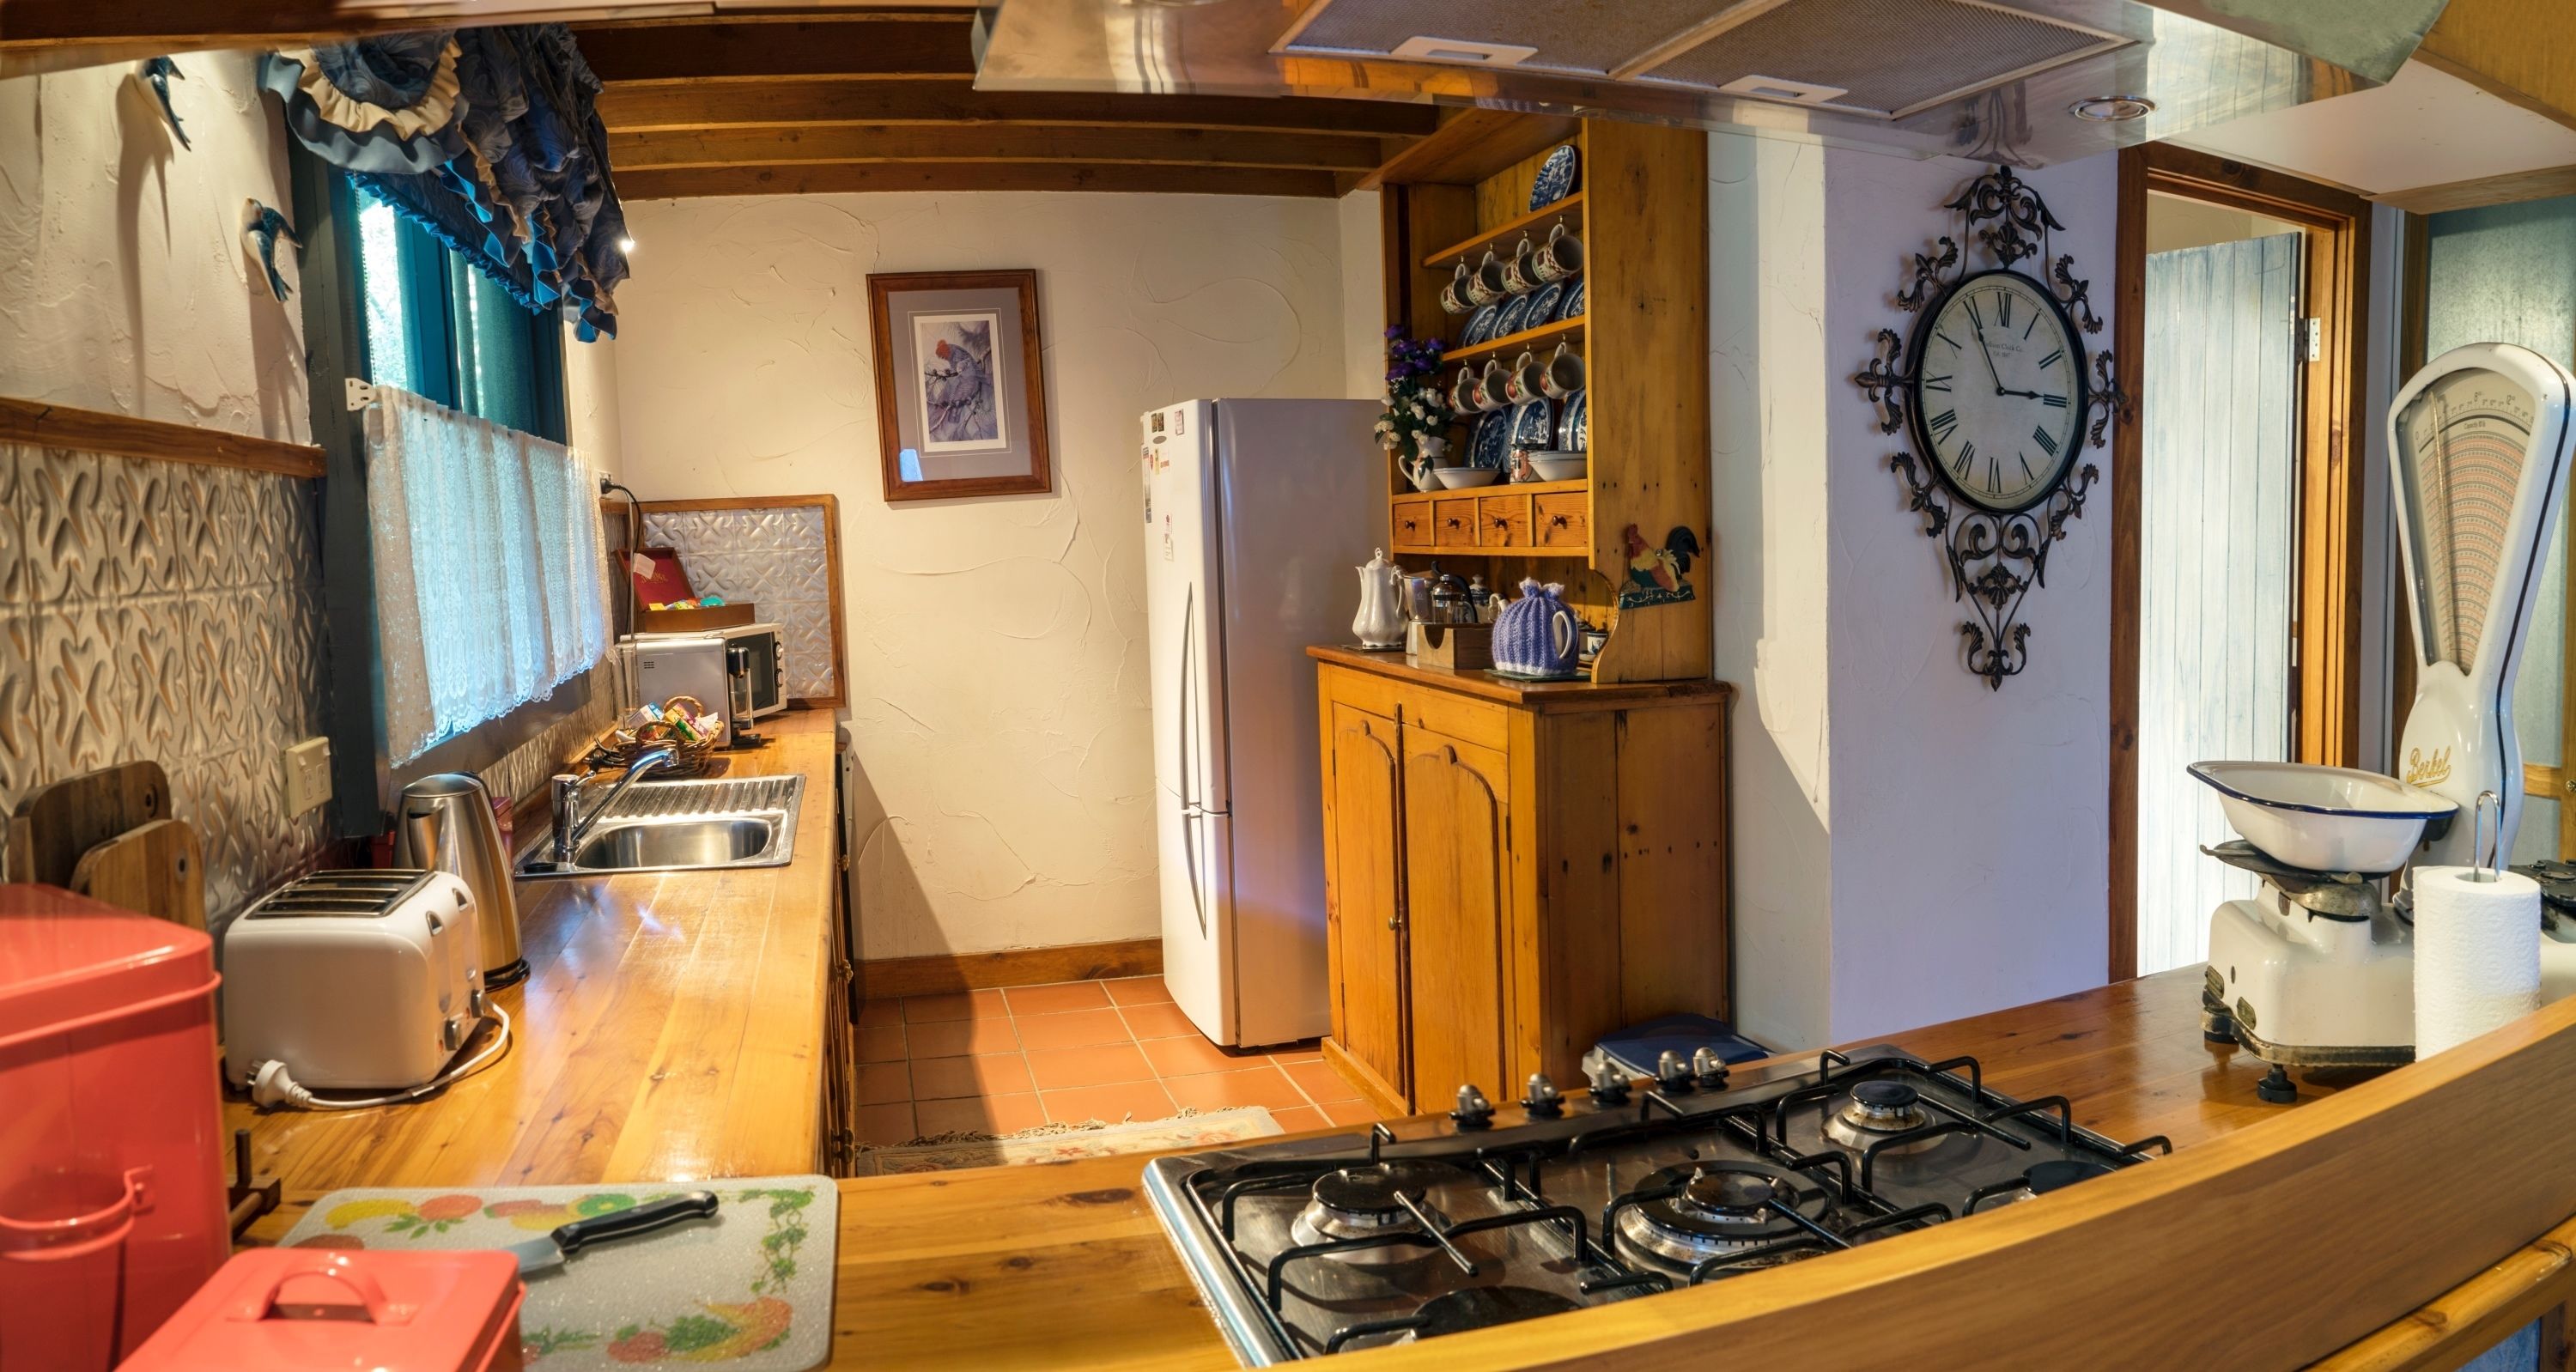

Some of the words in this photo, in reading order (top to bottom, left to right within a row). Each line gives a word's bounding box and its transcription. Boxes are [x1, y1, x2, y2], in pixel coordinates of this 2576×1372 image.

[1994, 292, 2012, 328] XII
[1930, 407, 1959, 446] VIII
[1953, 440, 1976, 481] VII
[1988, 457, 2002, 494] VI
[2020, 451, 2034, 486] V
[2407, 745, 2451, 786] Berkel
